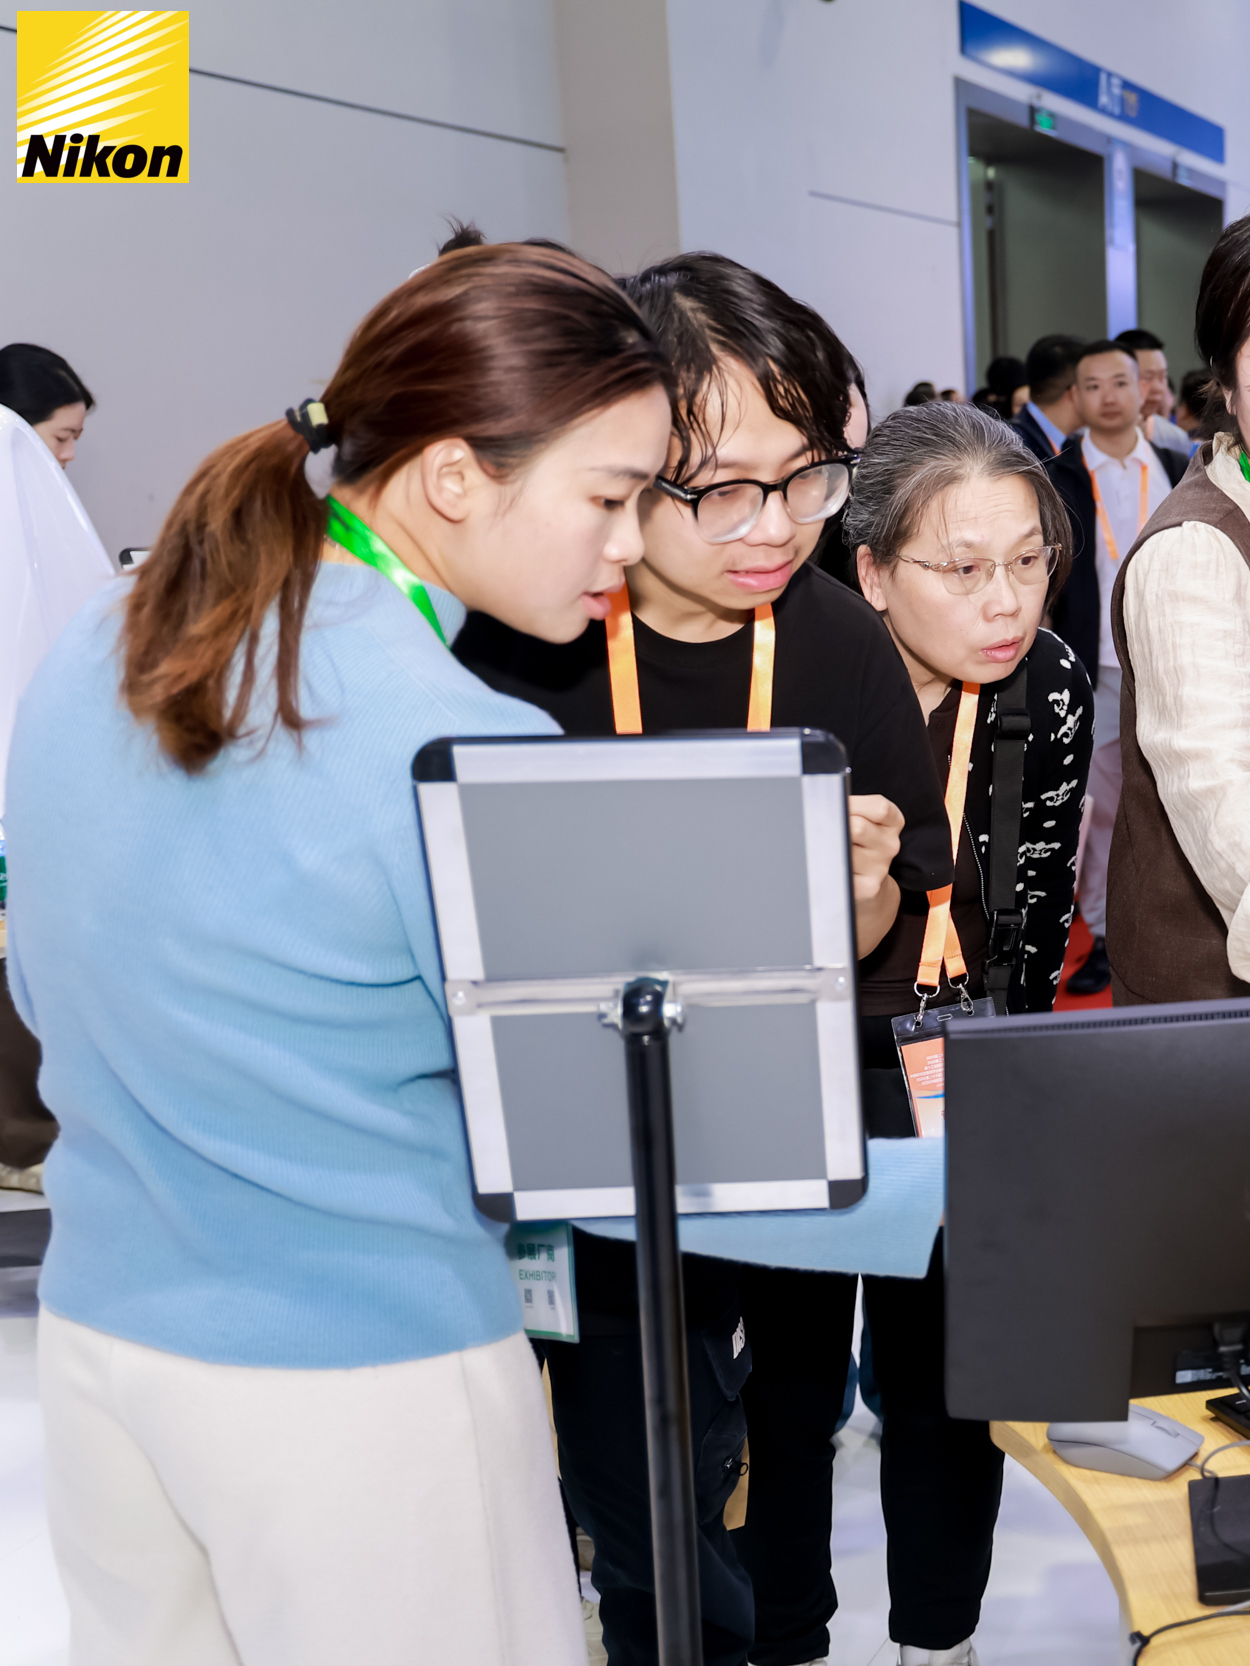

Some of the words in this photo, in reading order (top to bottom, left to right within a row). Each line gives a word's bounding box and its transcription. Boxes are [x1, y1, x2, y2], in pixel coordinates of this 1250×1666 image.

[516, 1243, 555, 1262] 参展厂商
[518, 1270, 556, 1282] EXHIBITOR
